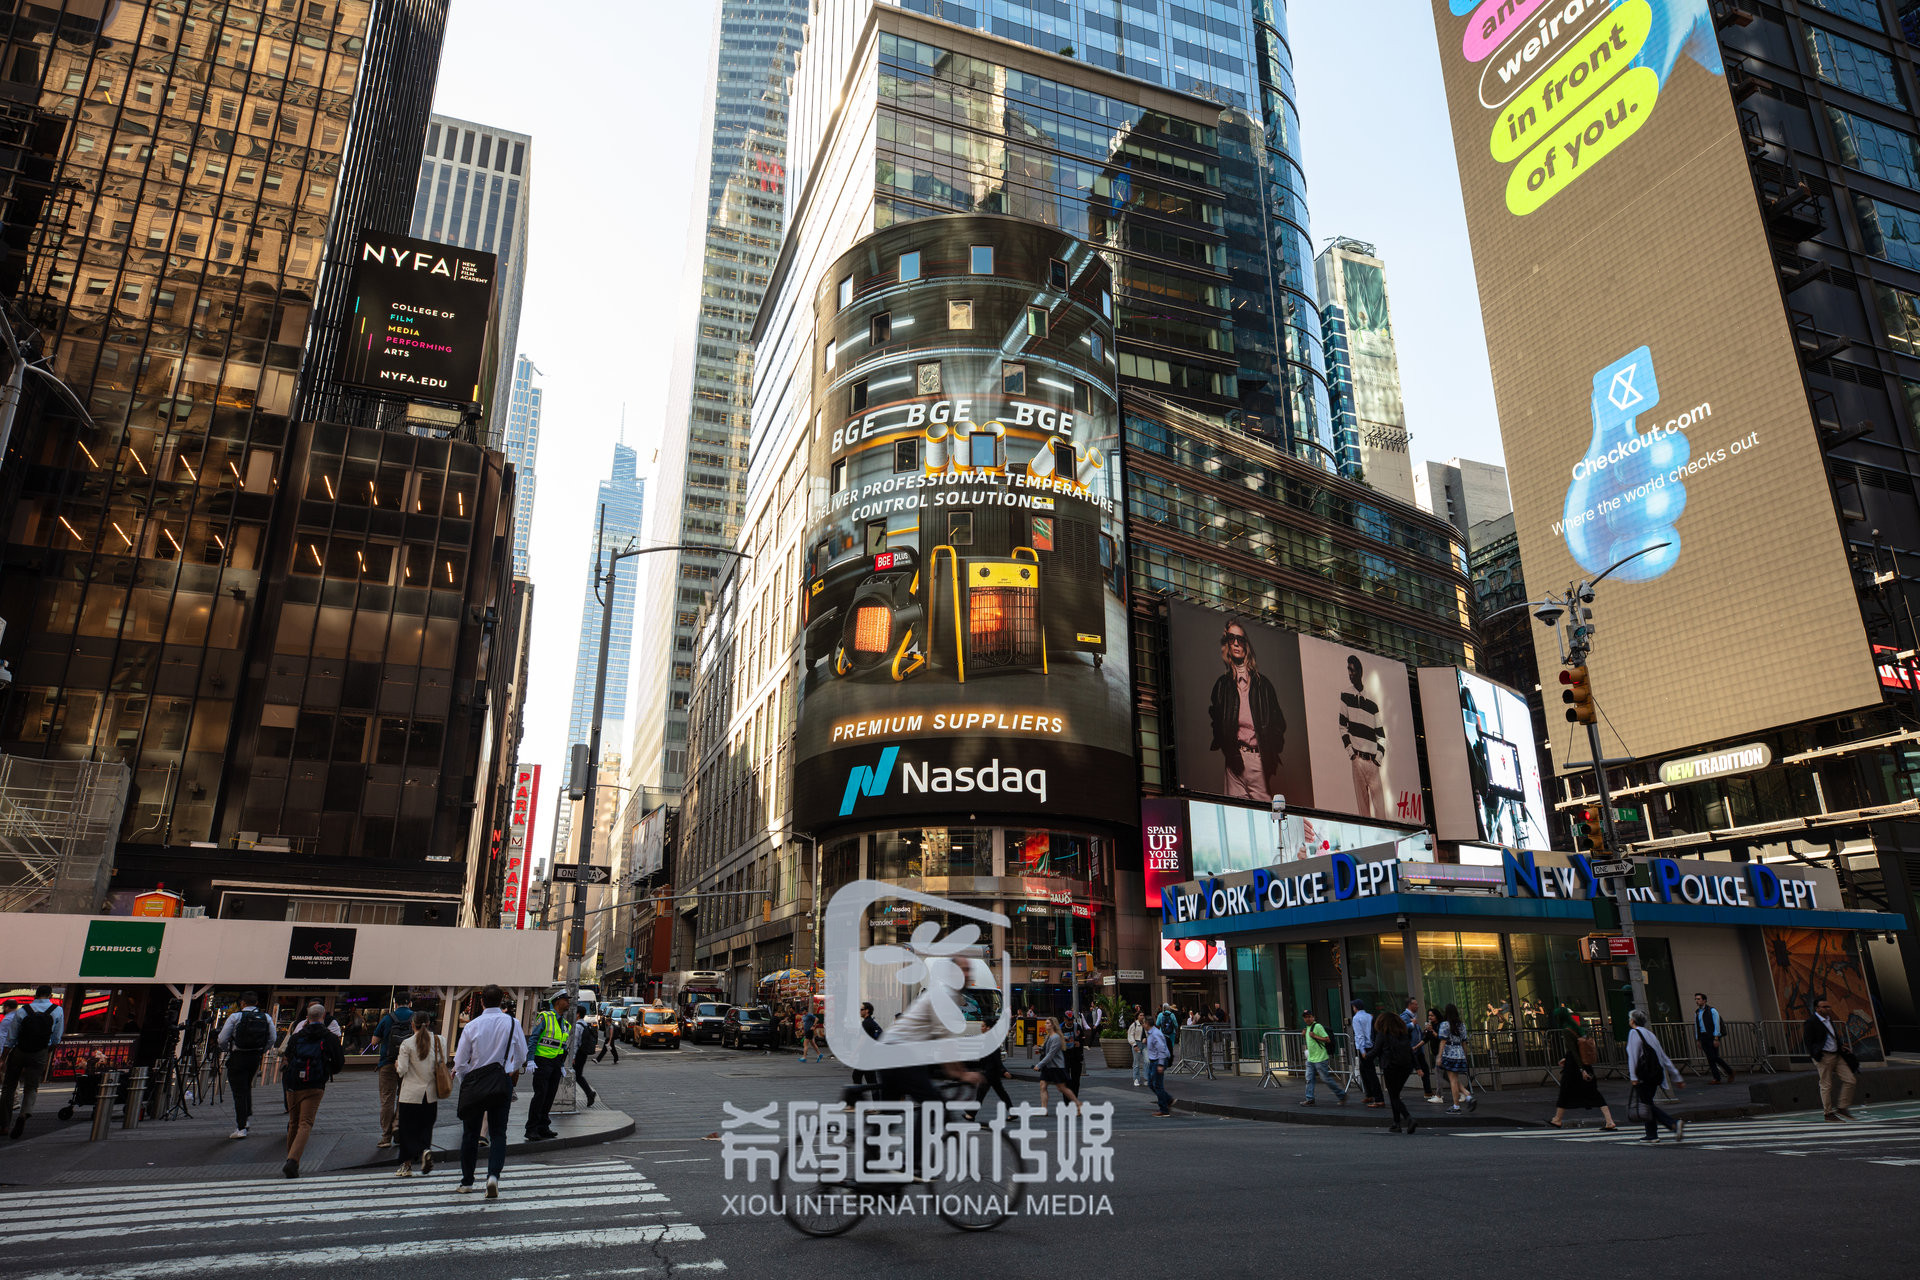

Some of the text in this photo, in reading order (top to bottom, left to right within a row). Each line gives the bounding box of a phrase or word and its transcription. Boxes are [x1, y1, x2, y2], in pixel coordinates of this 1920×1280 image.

[1482, 0, 1525, 40] an
[1507, 22, 1628, 142] in front
[1526, 98, 1639, 192] of you.
[362, 242, 450, 277] NYFA
[460, 275, 488, 284] ACADEMY
[390, 313, 414, 324] FILM
[391, 302, 456, 320] COLLEGE OF
[387, 325, 420, 336] MEDIA
[383, 348, 410, 357] ARTS
[386, 335, 453, 353] PERFORMING
[380, 370, 448, 388] NYFA.EDU
[831, 399, 1074, 454] BGE BGE BGE
[1571, 402, 1712, 481] Checkout.com
[1551, 431, 1760, 536] Where the world checks out
[815, 489, 859, 524] DELIVER
[862, 469, 996, 498] PROFESSIONAL
[1005, 472, 1115, 514] TEMPERATURE
[850, 495, 929, 522] CONTROL
[933, 490, 1044, 509] SOLUTIONS
[877, 555, 891, 567] BGE
[833, 713, 1063, 742] PREMIUM SUPPLIERS
[902, 759, 1047, 804] Nasdaq
[514, 772, 531, 825] PARK
[1397, 791, 1421, 822] H&M
[1147, 826, 1177, 834] SPAIN
[1148, 834, 1177, 850] UP
[1149, 850, 1178, 858] YOUR
[1149, 858, 1179, 869] LIFE
[561, 869, 578, 878] ONE
[1502, 848, 1576, 898] NEW
[1655, 858, 1750, 906] POLICE
[1748, 863, 1817, 909] DEPT
[1595, 863, 1629, 873] ONE WAY
[503, 857, 521, 912] PARK
[1160, 852, 1398, 925] NEW YORK POLICE DEPT
[1026, 906, 1047, 914] Nasdaq
[89, 945, 142, 953] STARBUCKS
